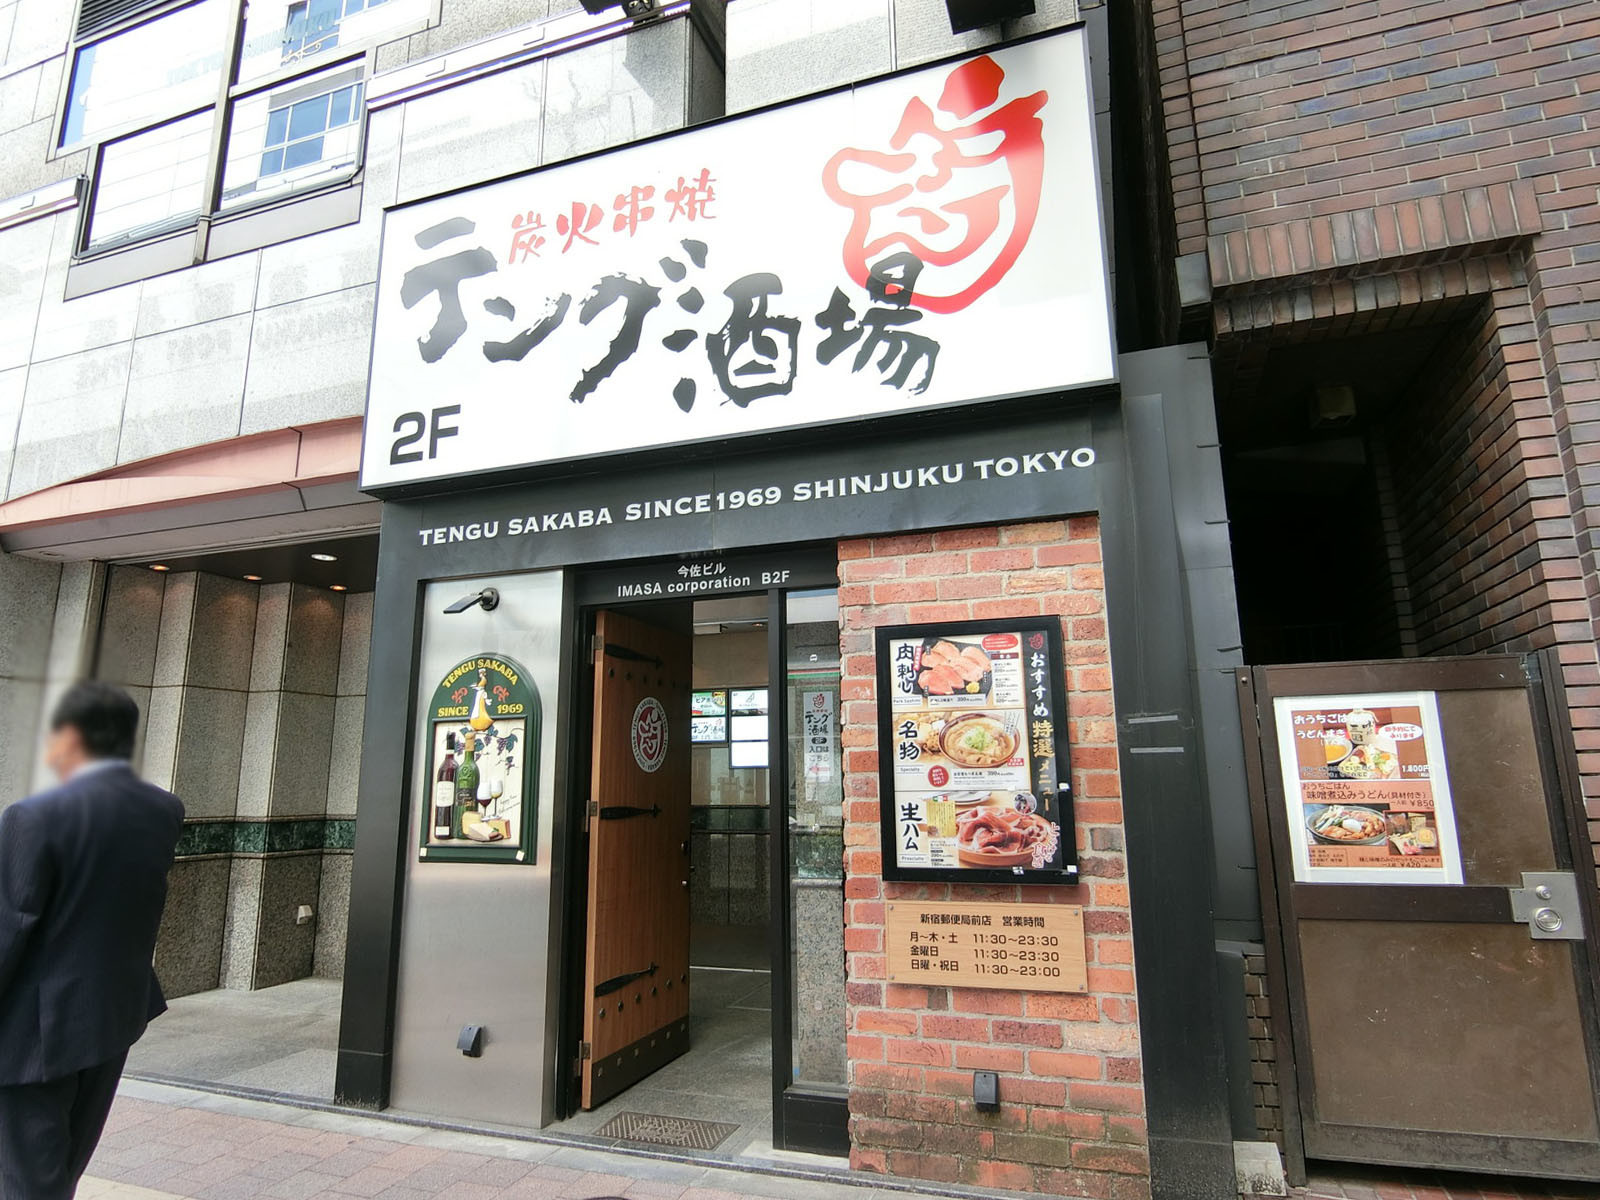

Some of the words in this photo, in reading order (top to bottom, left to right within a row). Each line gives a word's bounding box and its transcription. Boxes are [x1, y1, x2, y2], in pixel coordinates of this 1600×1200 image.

[508, 167, 718, 265] 炭火串焼
[401, 216, 941, 413] テング酒場
[389, 405, 461, 466] 2F
[419, 520, 500, 546] TENGU
[507, 507, 613, 536] SAKABA
[625, 493, 713, 522] SINCE
[716, 487, 782, 512] 1969
[793, 461, 963, 502] SHINJUKU
[974, 447, 1096, 481] TOKYO
[617, 583, 662, 597] IMASA
[668, 574, 750, 593] corporation
[761, 570, 790, 585] B2F
[677, 562, 726, 577] 今佐ビル
[442, 660, 475, 688] TENGU
[477, 659, 519, 685] SAKABA
[896, 643, 914, 693] 肉刺し
[438, 706, 469, 717] SINCE
[496, 703, 523, 714] 1969
[805, 711, 832, 724] テング
[899, 721, 920, 760] 名物
[900, 802, 923, 850] 生ハム
[920, 913, 992, 926] 新宿郵便局前店
[1002, 915, 1045, 928] 営業時間
[910, 945, 939, 957] 金曜日
[911, 959, 959, 972] 日曜・祝日
